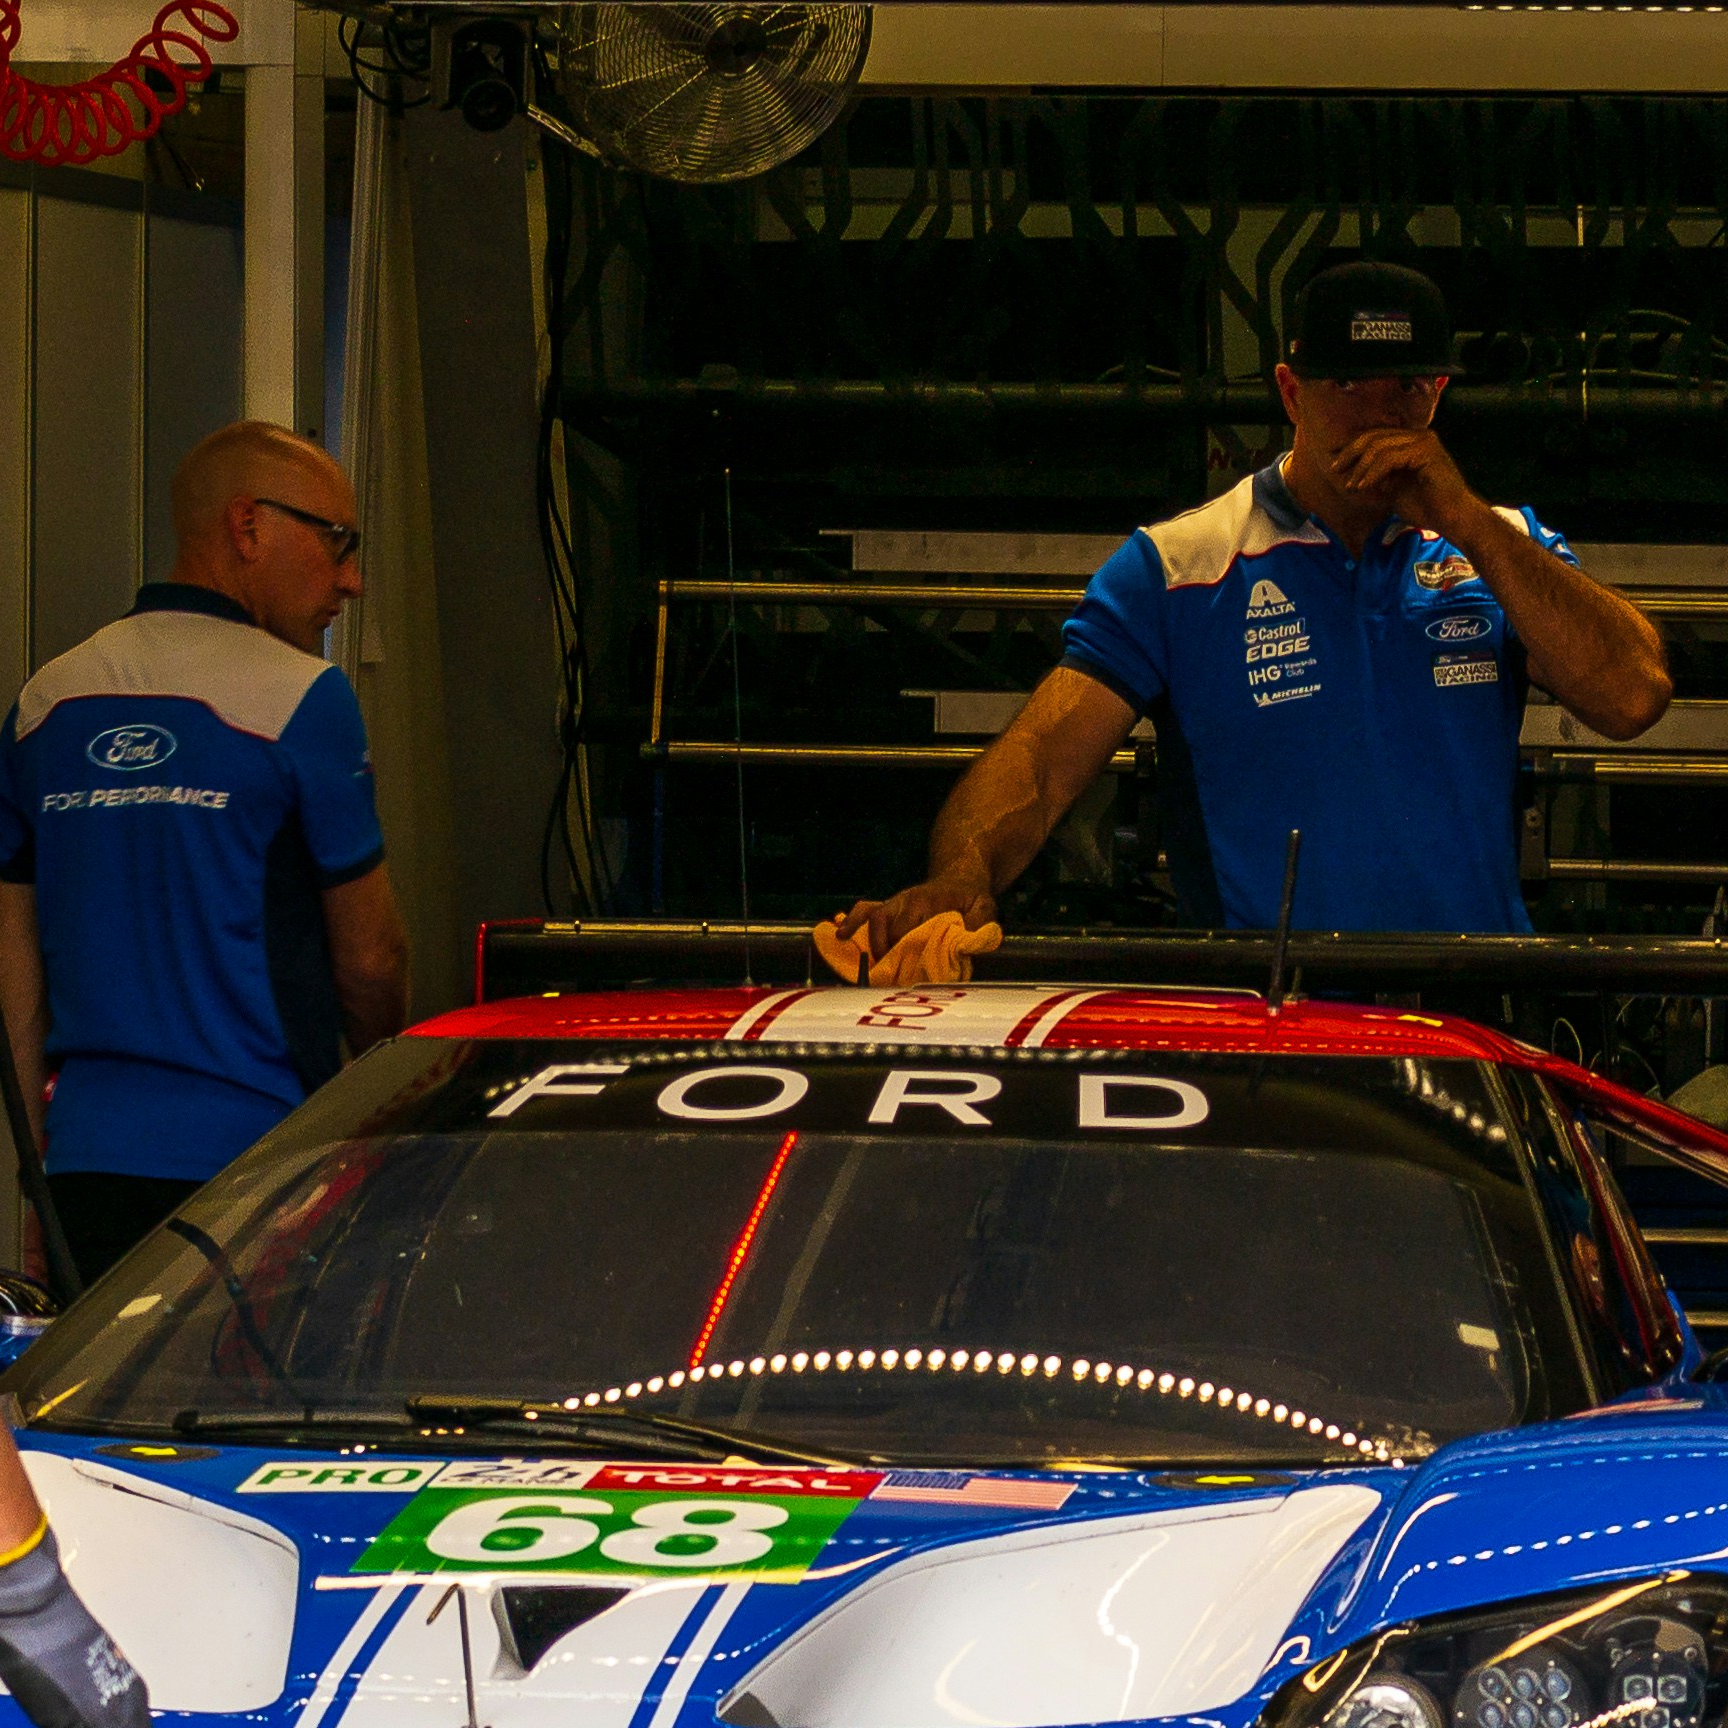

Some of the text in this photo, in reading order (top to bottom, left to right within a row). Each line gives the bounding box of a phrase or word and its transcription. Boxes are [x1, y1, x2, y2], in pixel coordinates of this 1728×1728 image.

[1246, 604, 1295, 620] AXALTA
[1259, 622, 1301, 640] Castrol
[1439, 620, 1479, 638] Ford
[1246, 636, 1310, 663] EDGE
[1249, 665, 1281, 686] IHG
[1447, 663, 1496, 677] GANASSI
[106, 731, 161, 763] Ford
[41, 785, 231, 813] FOR PEORANCE
[486, 1064, 1211, 1130] FORD
[254, 1468, 424, 1487] PRO
[625, 1468, 854, 1491] TOTAL
[427, 1496, 790, 1567] 68
